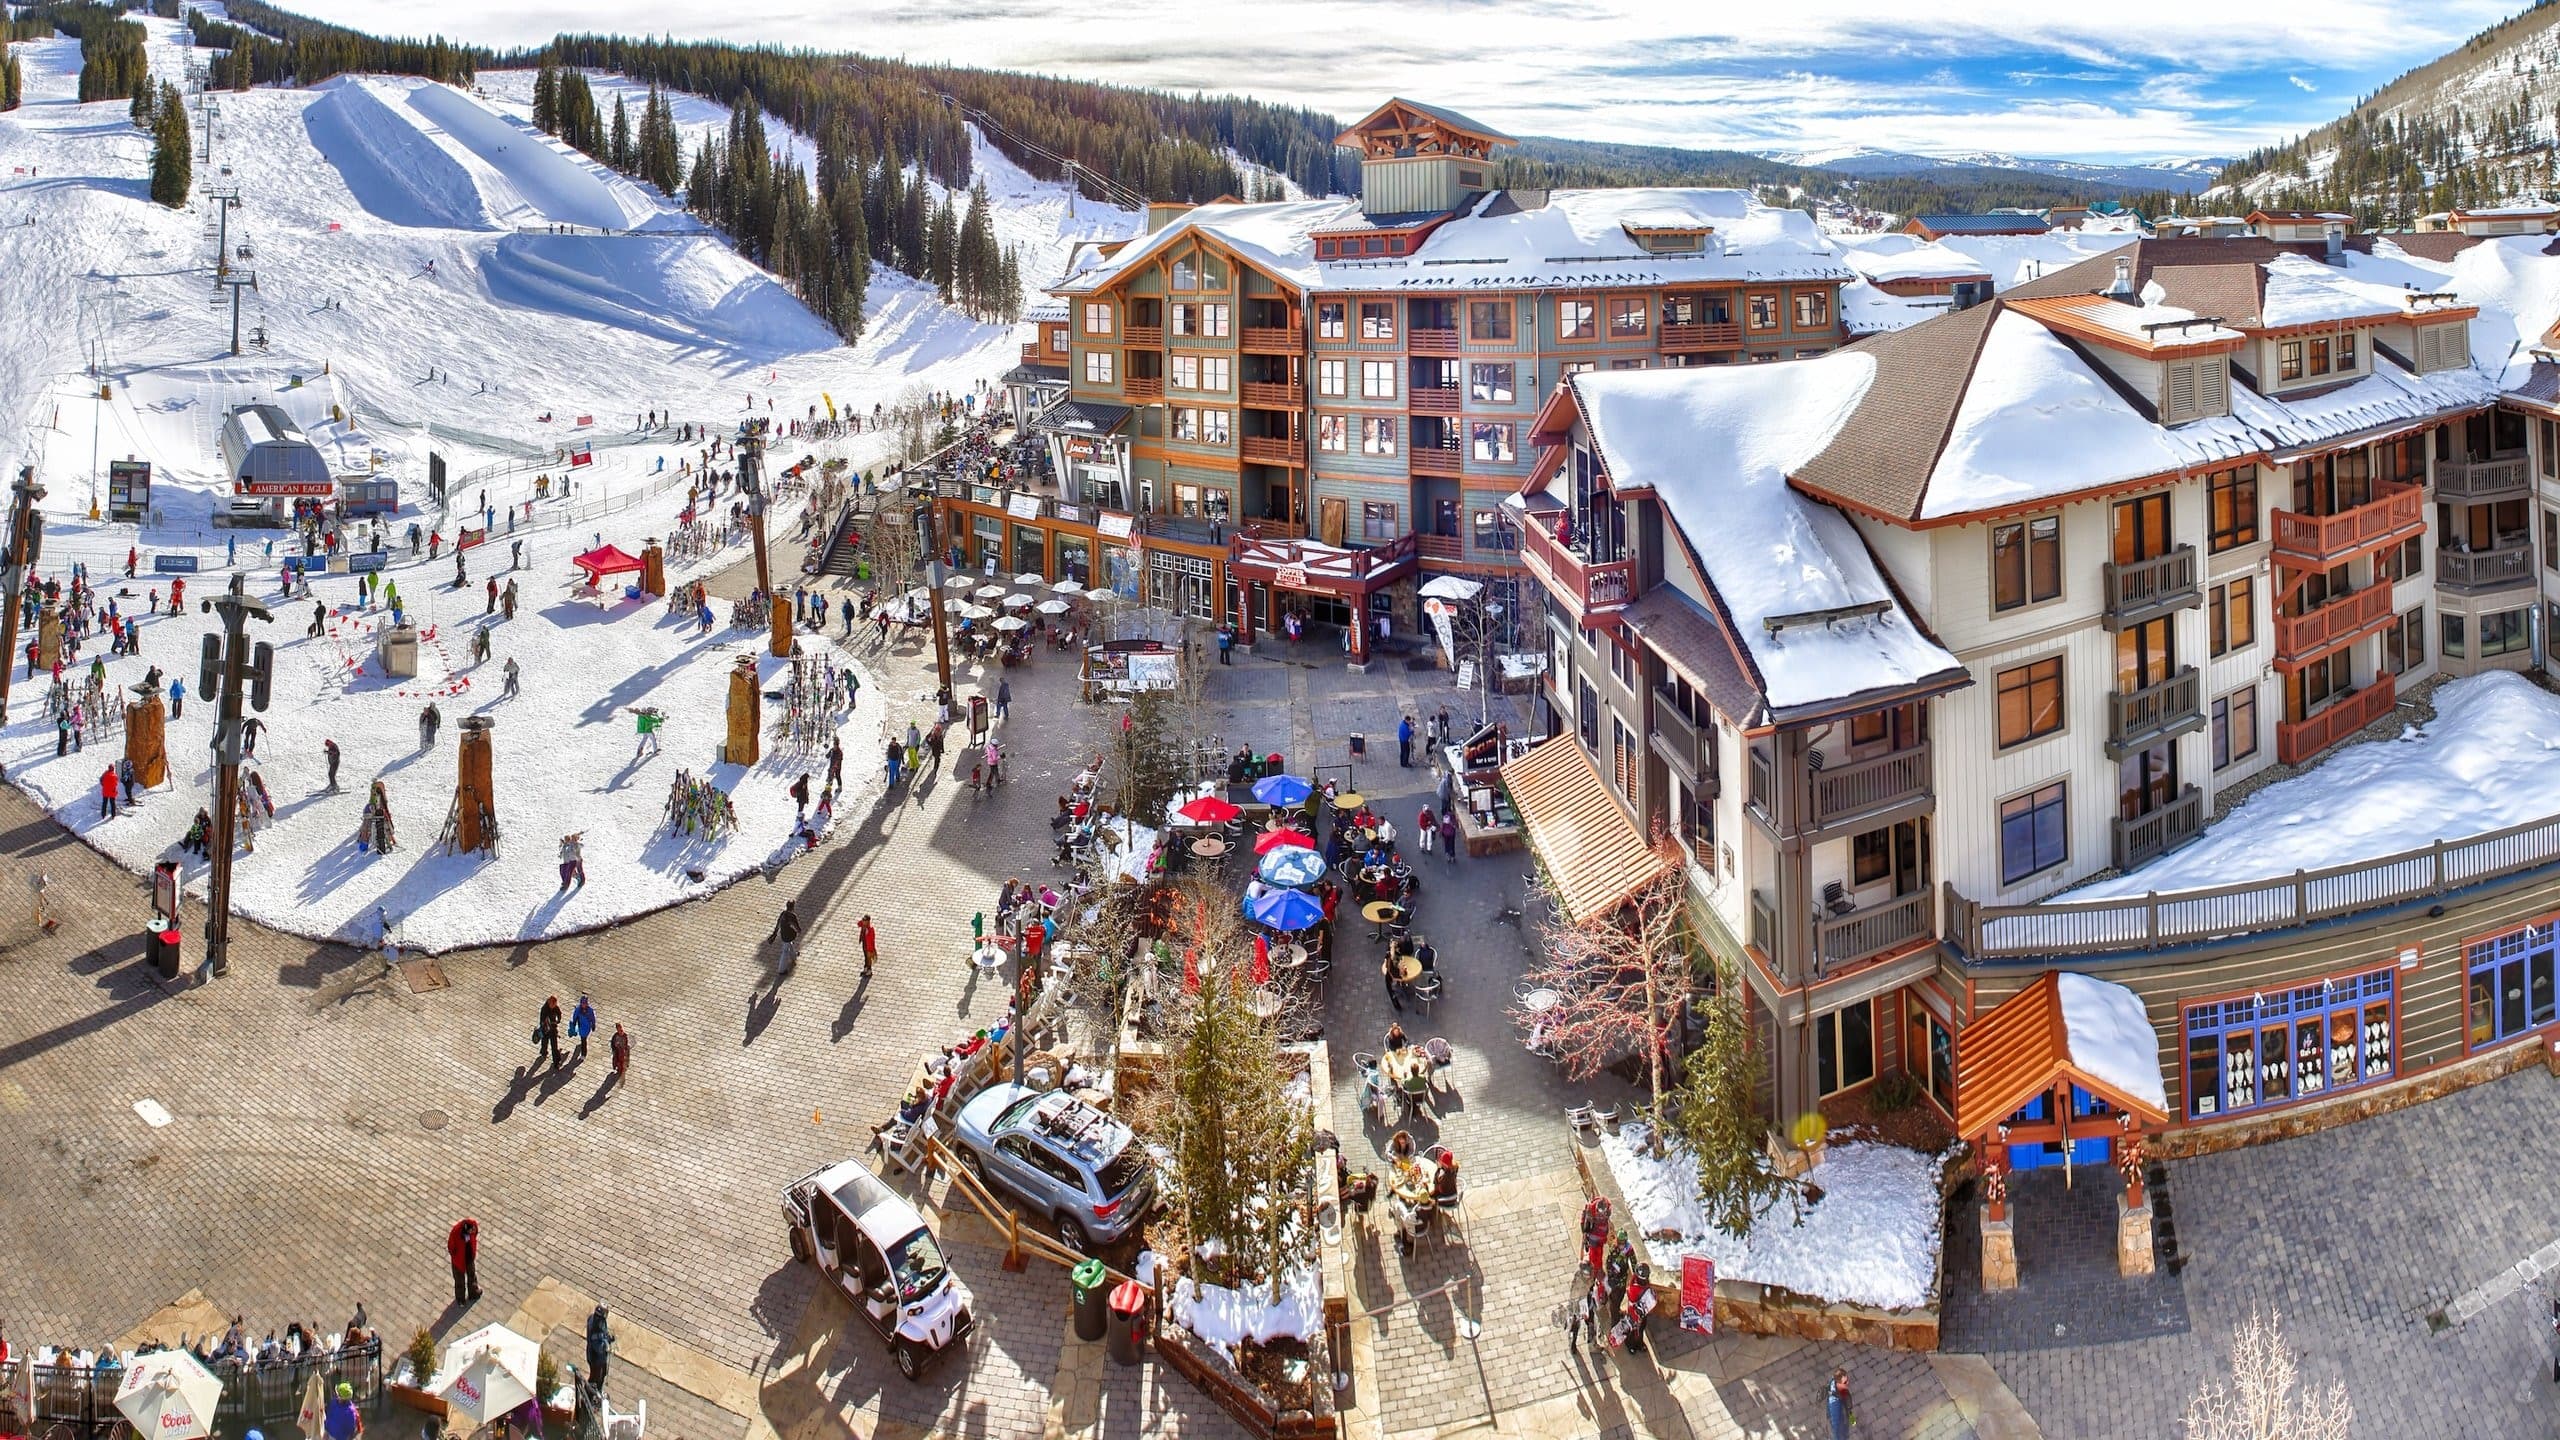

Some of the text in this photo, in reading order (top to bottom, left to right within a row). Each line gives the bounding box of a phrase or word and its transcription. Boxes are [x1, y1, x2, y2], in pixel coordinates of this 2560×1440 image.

[255, 485, 327, 493] AMERICAN EAGLE
[1277, 567, 1305, 577] COPPER
[456, 1376, 481, 1400] Coors
[162, 1413, 193, 1429] Coors
